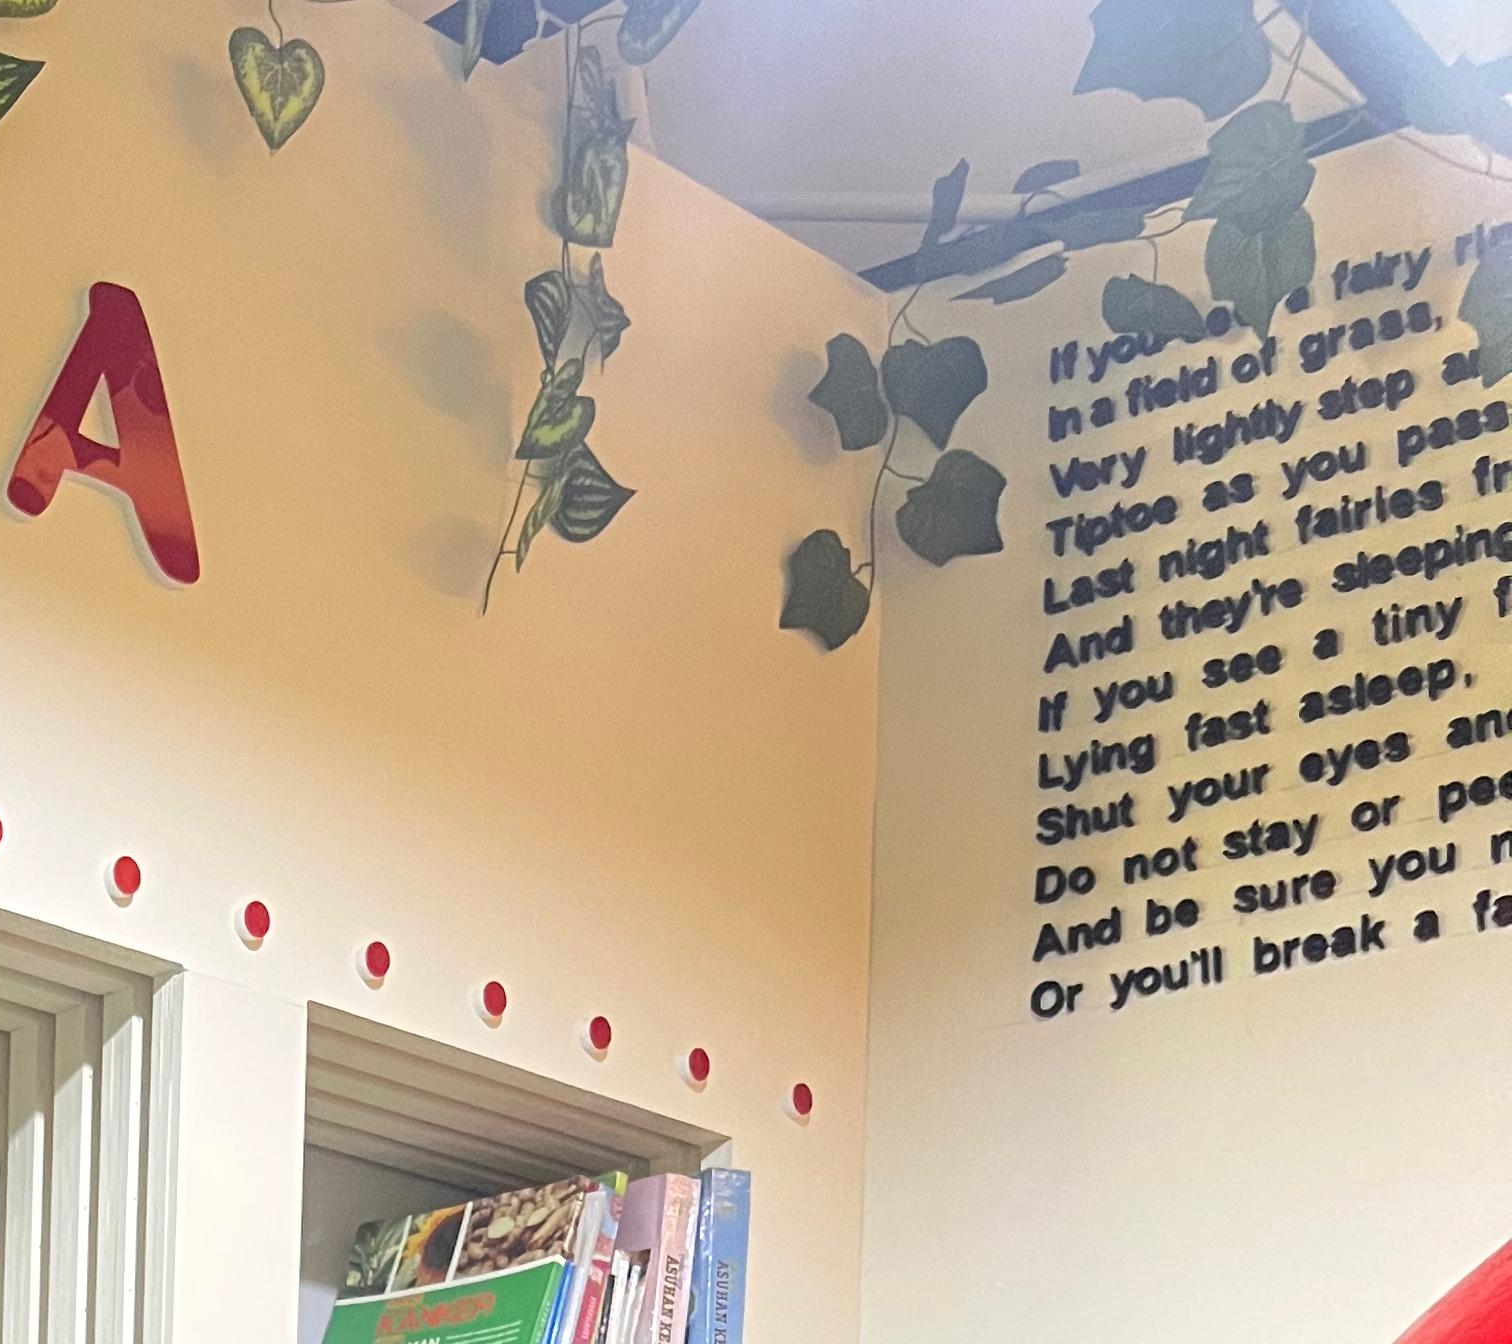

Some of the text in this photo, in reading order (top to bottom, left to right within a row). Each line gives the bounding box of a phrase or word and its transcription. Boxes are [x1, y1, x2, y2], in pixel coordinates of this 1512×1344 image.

[1332, 246, 1432, 300] fairy
[1048, 406, 1083, 442] In
[1090, 396, 1115, 429] a
[1126, 356, 1218, 416] field
[1230, 335, 1278, 383] of
[1298, 301, 1443, 374] grass,
[6, 280, 200, 586] A
[1049, 445, 1147, 498] Very
[1173, 398, 1302, 465] lightly
[1317, 369, 1415, 420] step
[1043, 557, 1135, 615] Last
[1158, 519, 1270, 582] night
[1295, 479, 1444, 545] fairies
[1045, 495, 1178, 557] Tiptoe
[1202, 473, 1255, 512] as
[1281, 441, 1366, 500] you
[1038, 690, 1068, 733] If
[1094, 670, 1174, 723] you
[1202, 644, 1282, 688] see
[1312, 627, 1339, 661] a
[1371, 596, 1463, 646] tiny
[1043, 614, 1134, 673] And
[1158, 578, 1303, 640] they're
[1036, 793, 1136, 846] Shut
[1168, 763, 1270, 823] your
[1299, 731, 1412, 786] eyes
[1037, 732, 1156, 792] Lying
[1185, 699, 1272, 752] fast
[1032, 906, 1123, 963] And
[1145, 897, 1200, 938] be
[1233, 868, 1337, 915] sure
[1368, 841, 1457, 898] you
[1034, 865, 1096, 905] Do
[1123, 835, 1199, 886] not
[1222, 813, 1319, 862] stay
[1351, 795, 1402, 832] or
[1030, 980, 1084, 1019] Or
[1110, 945, 1223, 1011] you'll
[1252, 912, 1386, 977] break
[1414, 908, 1440, 943] a
[660, 1255, 681, 1320] ASUHAN
[714, 1260, 730, 1325] ASUHAN
